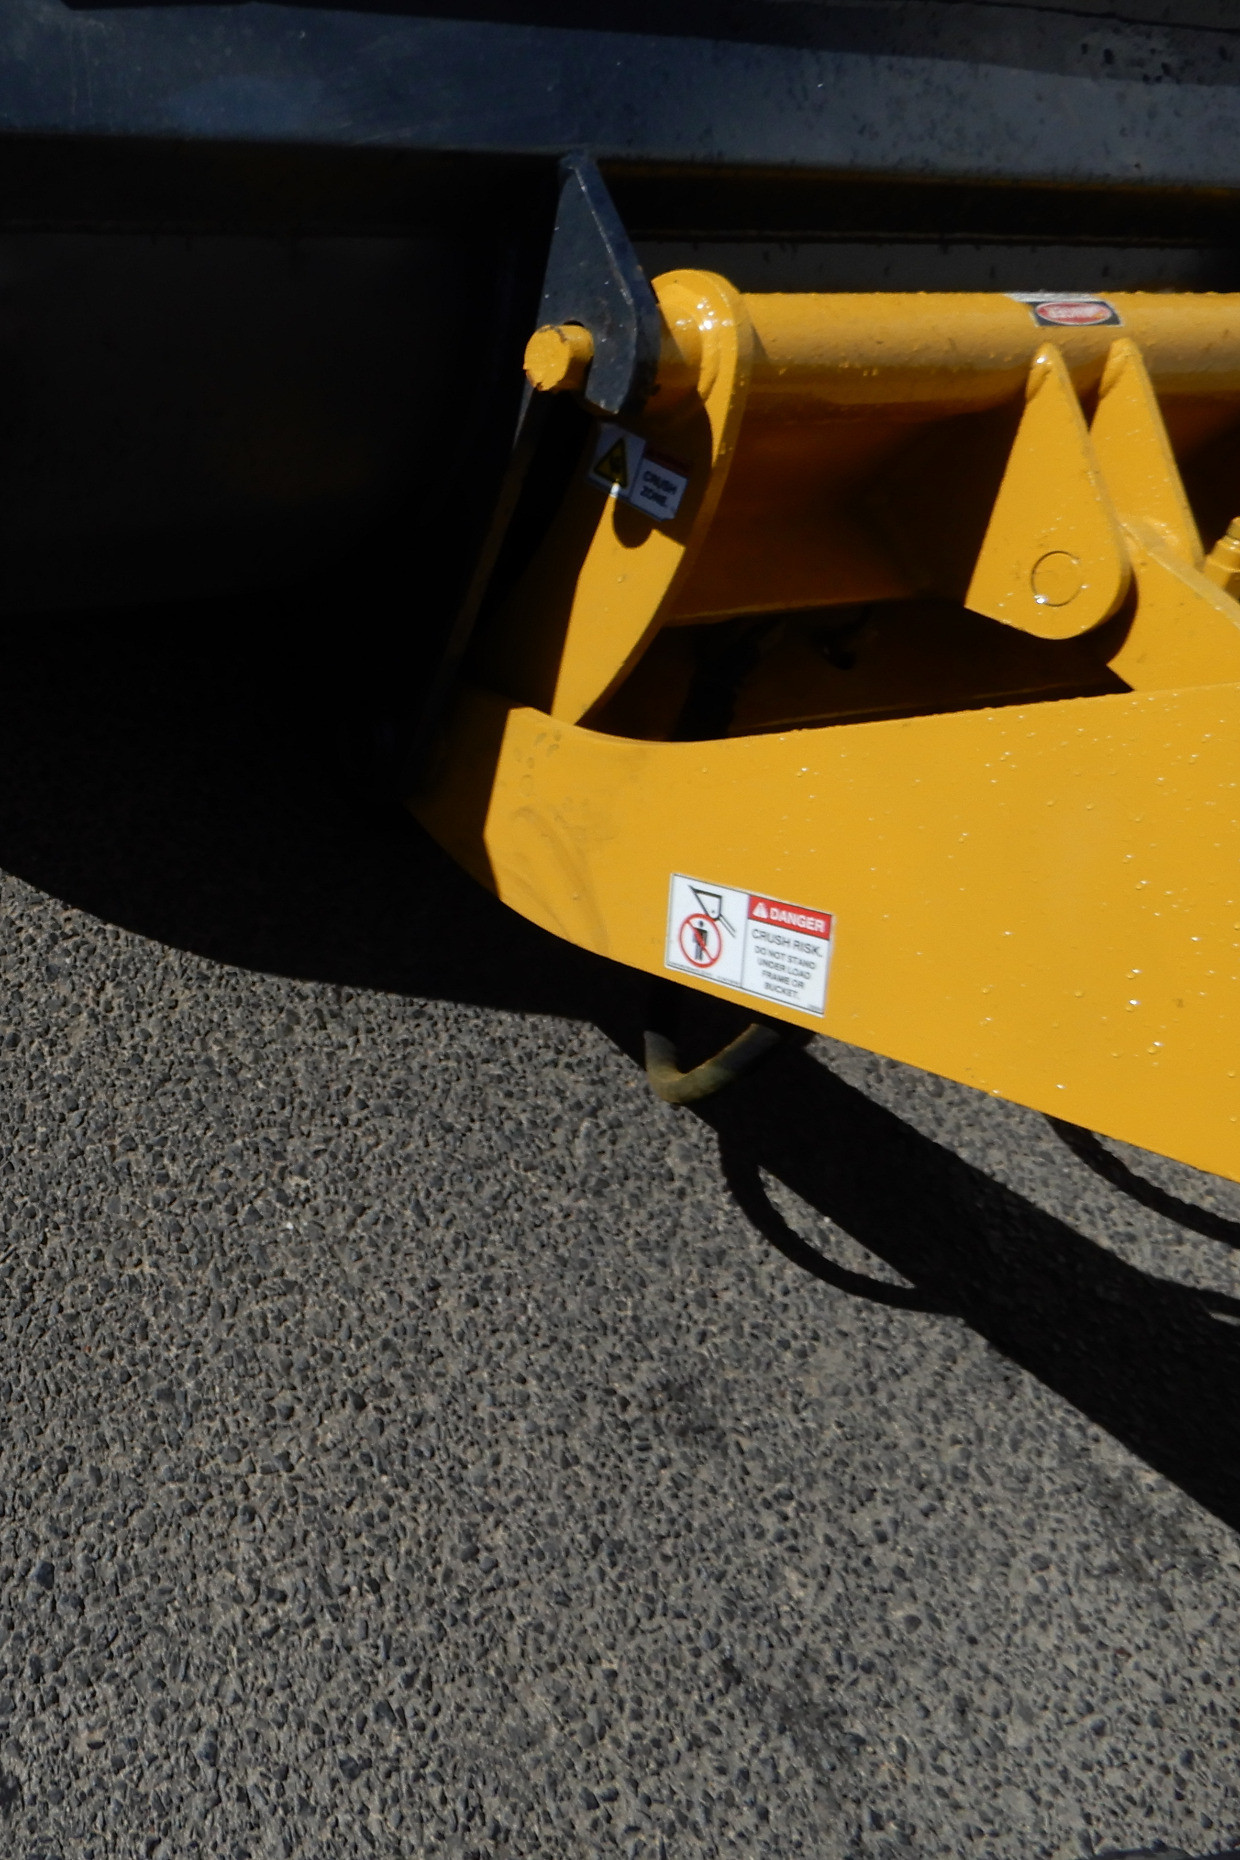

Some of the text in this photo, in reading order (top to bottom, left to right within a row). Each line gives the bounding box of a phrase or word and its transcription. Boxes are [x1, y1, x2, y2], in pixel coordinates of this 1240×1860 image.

[769, 907, 826, 933] DANGER
[751, 928, 823, 958] CRUSH RISK.
[754, 945, 816, 970] DO NOT STAND
[757, 957, 812, 980] UNDER LOAD
[761, 970, 805, 989] FRAME OR
